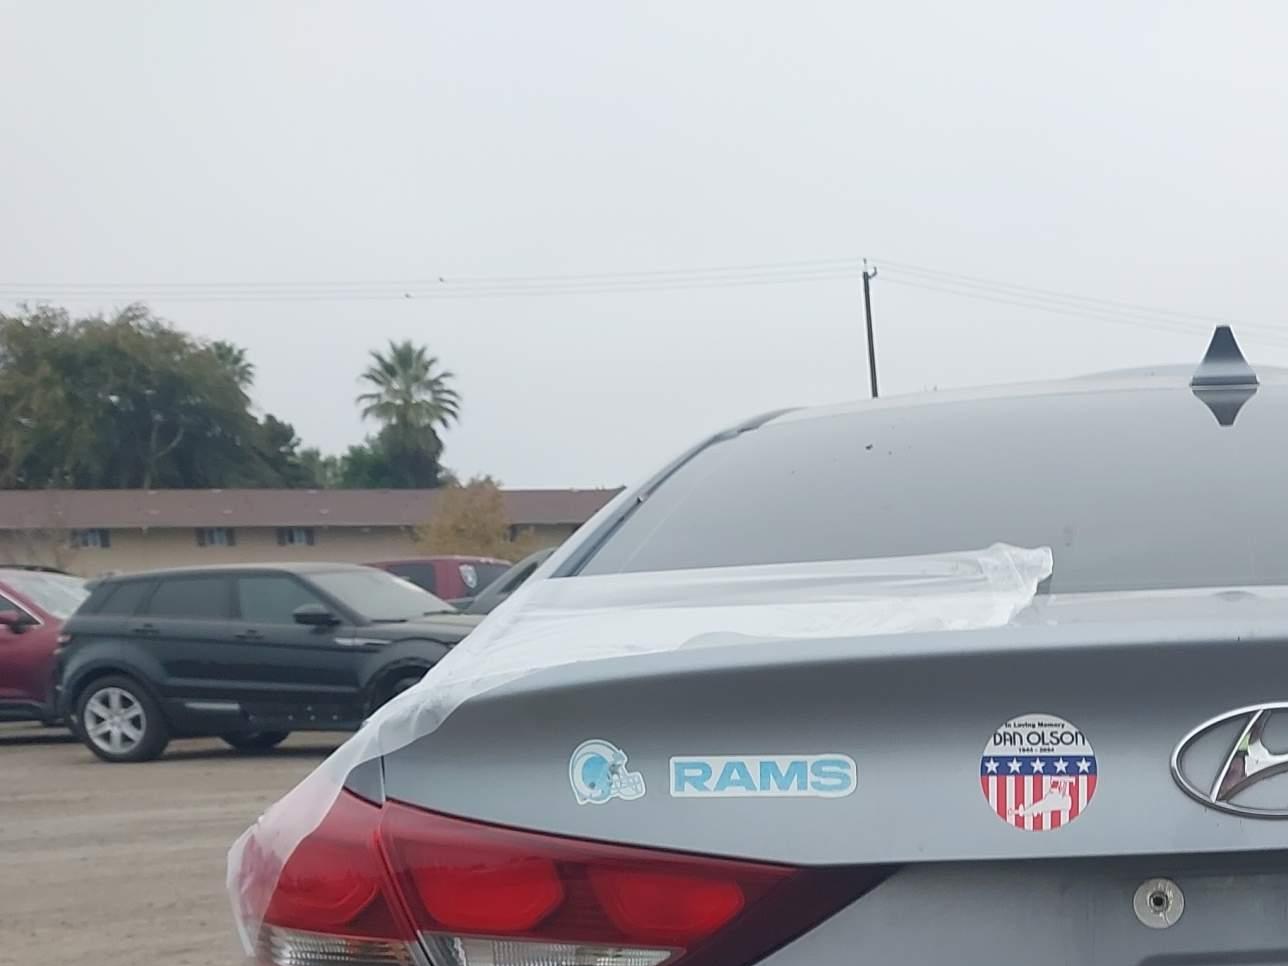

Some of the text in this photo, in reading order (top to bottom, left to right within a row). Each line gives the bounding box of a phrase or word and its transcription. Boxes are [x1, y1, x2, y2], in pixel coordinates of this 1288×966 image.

[1013, 721, 1036, 729] Loving
[1037, 721, 1065, 729] Memory
[993, 731, 1086, 746] DAN OLSON
[674, 759, 852, 793] RAMS
